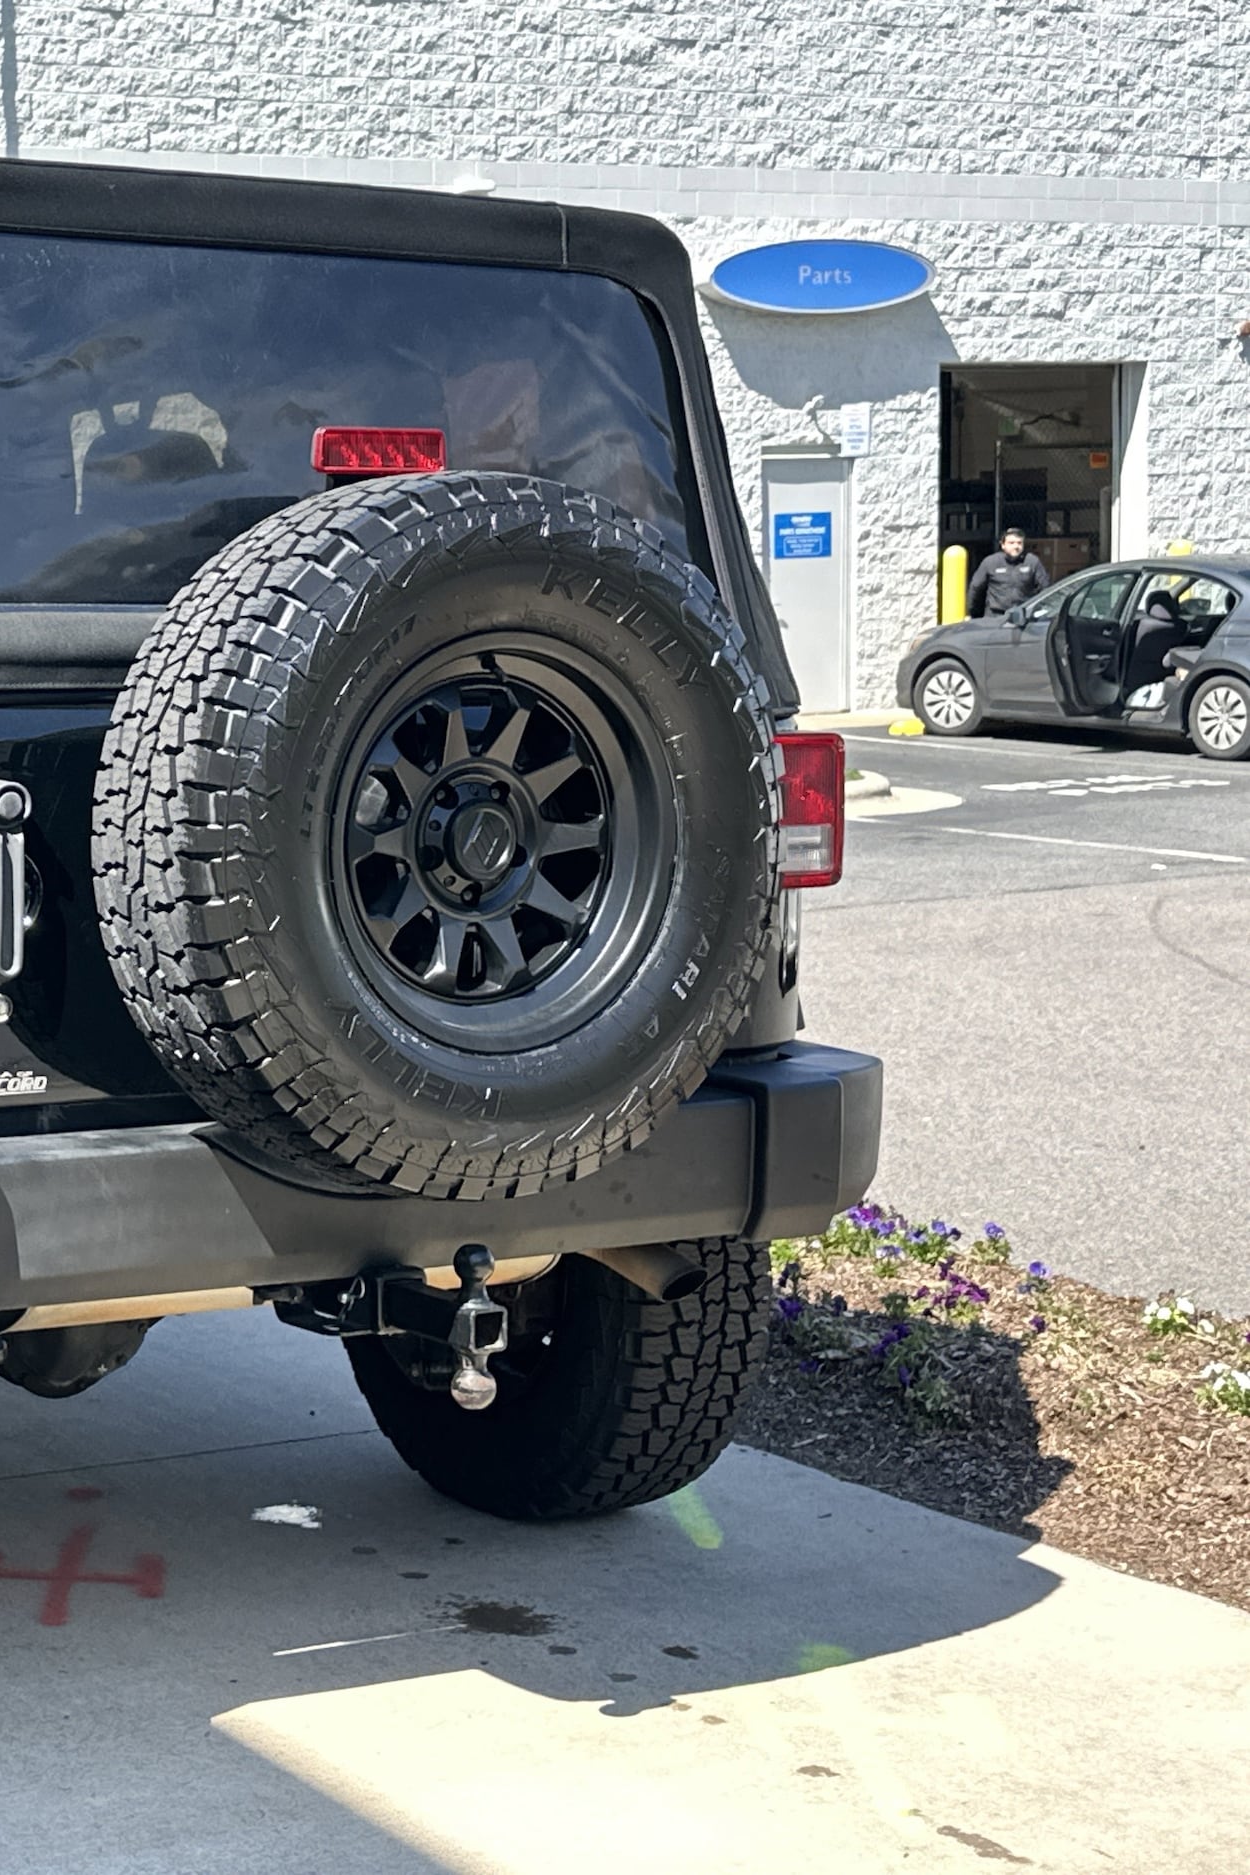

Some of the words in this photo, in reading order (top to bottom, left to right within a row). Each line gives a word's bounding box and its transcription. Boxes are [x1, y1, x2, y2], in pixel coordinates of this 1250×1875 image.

[798, 264, 852, 286] Parts
[541, 563, 715, 692] KELLY
[326, 1003, 502, 1118] KELLY
